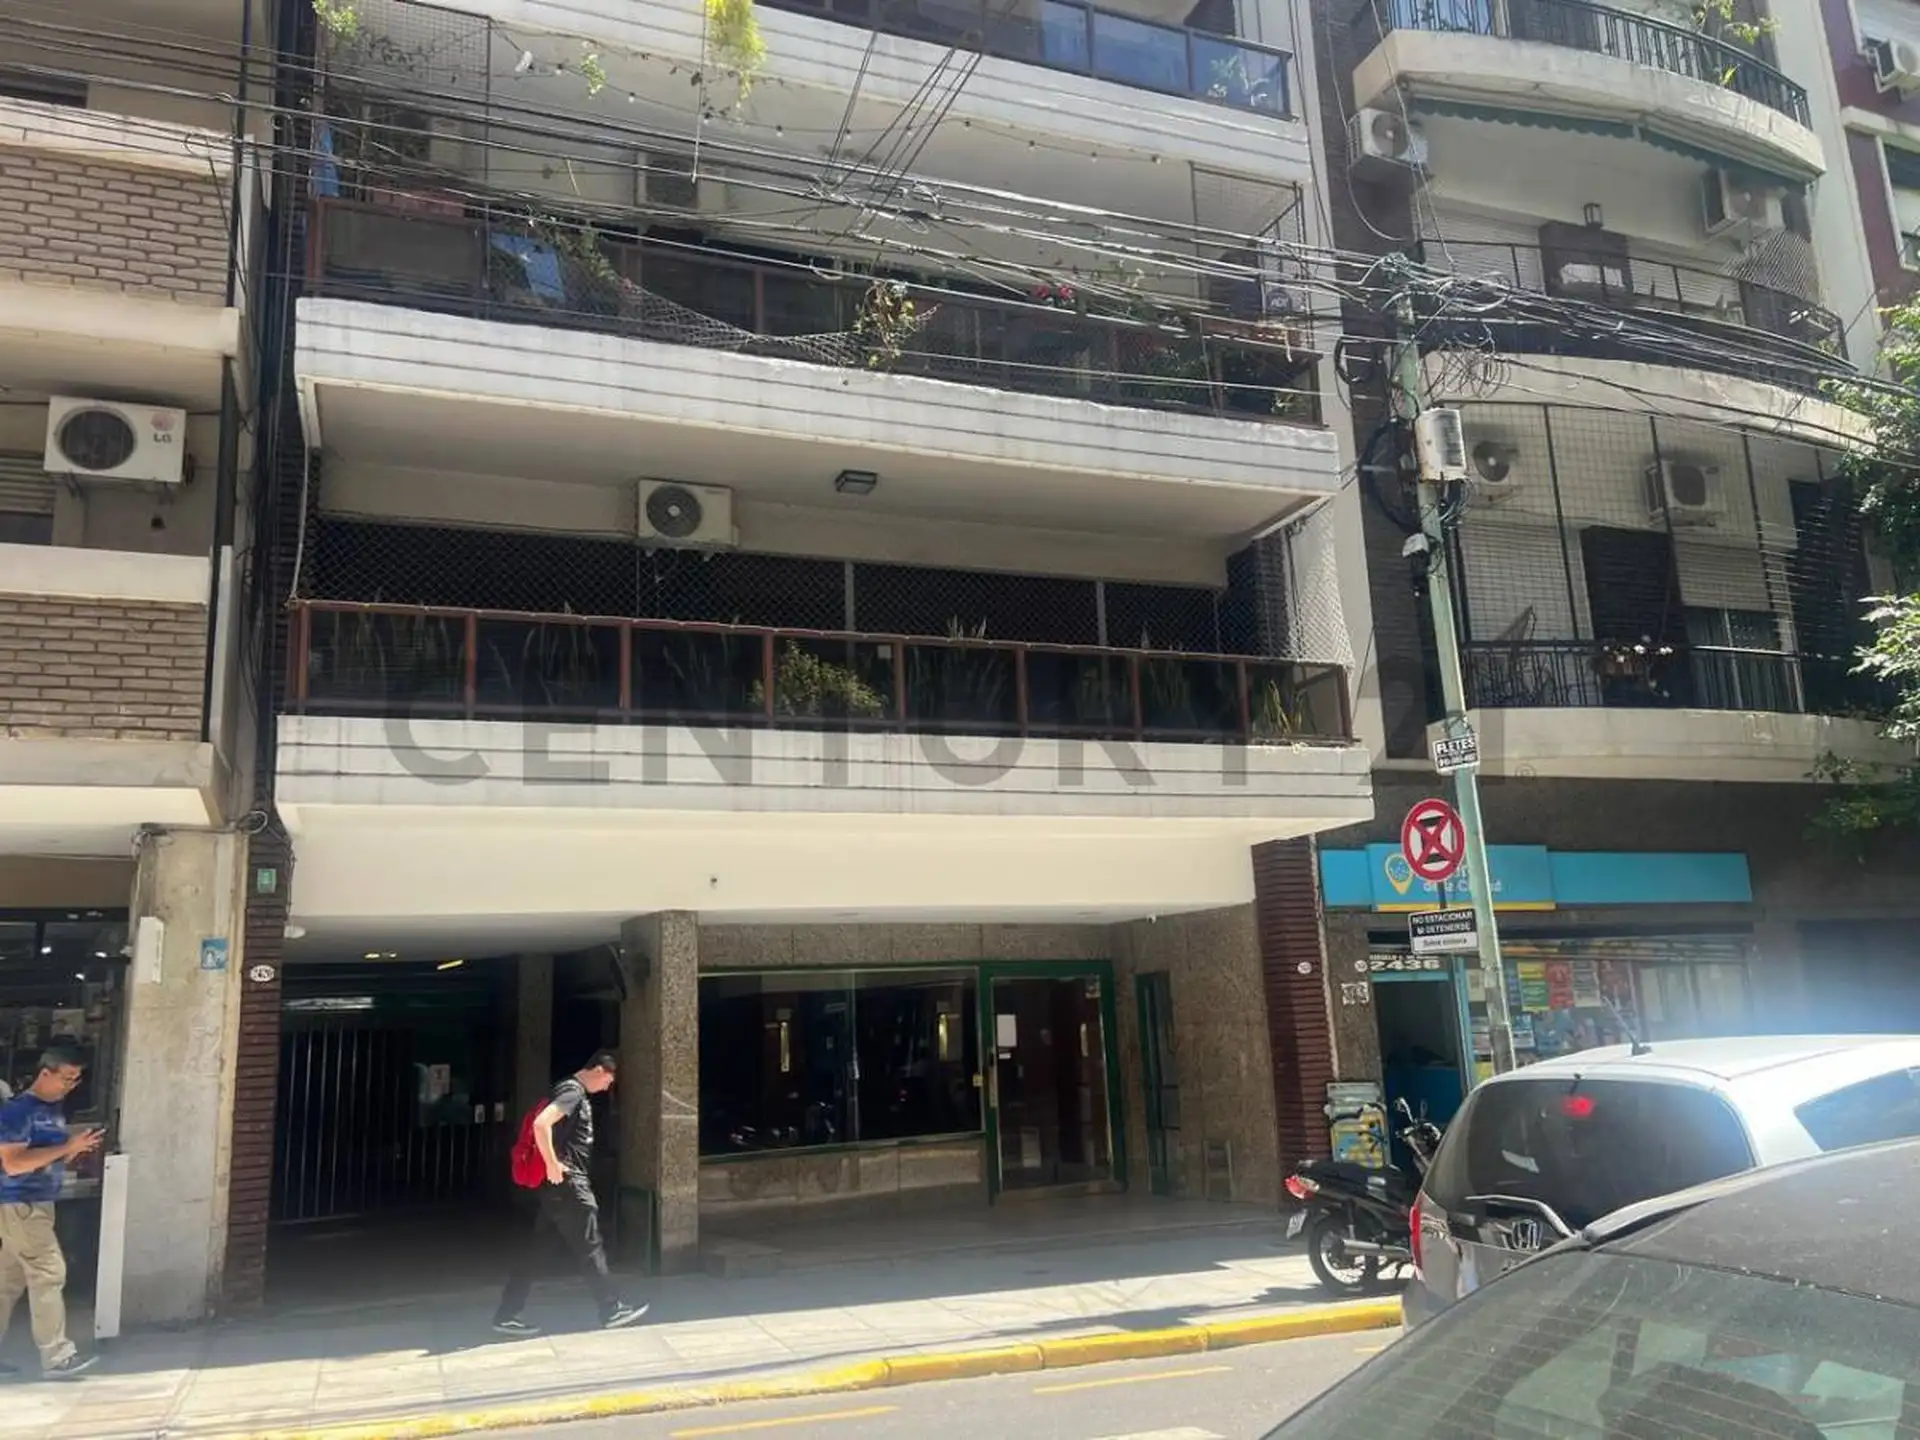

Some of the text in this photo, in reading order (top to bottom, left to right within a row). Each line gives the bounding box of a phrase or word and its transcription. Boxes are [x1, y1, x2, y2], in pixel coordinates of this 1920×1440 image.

[153, 432, 172, 444] LG
[1436, 737, 1475, 754] FLETES
[1412, 916, 1424, 924] NO
